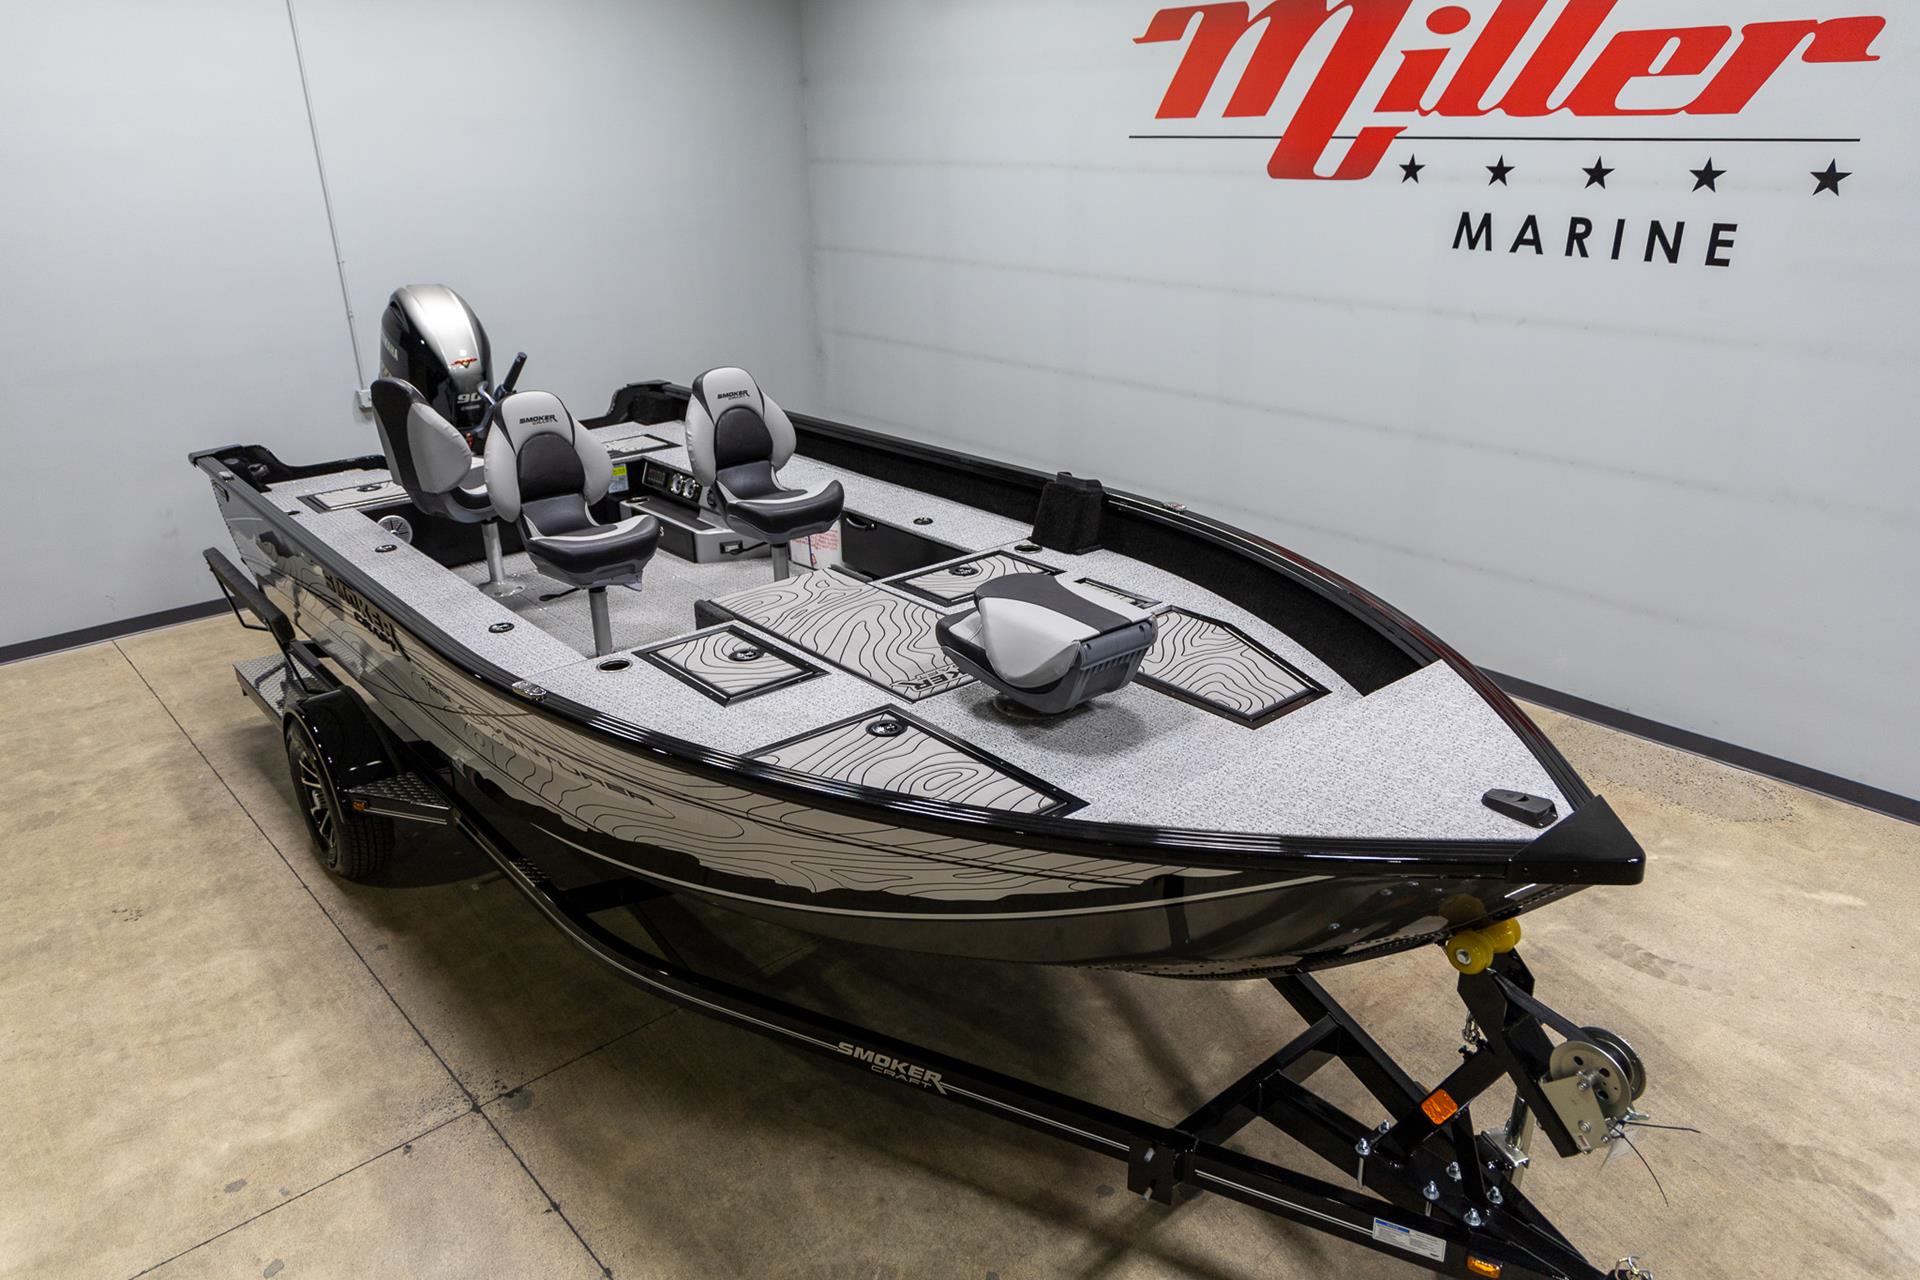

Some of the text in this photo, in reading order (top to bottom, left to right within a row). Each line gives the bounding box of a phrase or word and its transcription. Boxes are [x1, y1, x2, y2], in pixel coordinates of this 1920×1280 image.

[1133, 0, 1886, 180] Miller
[1452, 210, 1738, 267] MARINE
[519, 414, 559, 425] SMOKER
[837, 1041, 949, 1096] SMOKER
[871, 1064, 933, 1089] CRAFT
